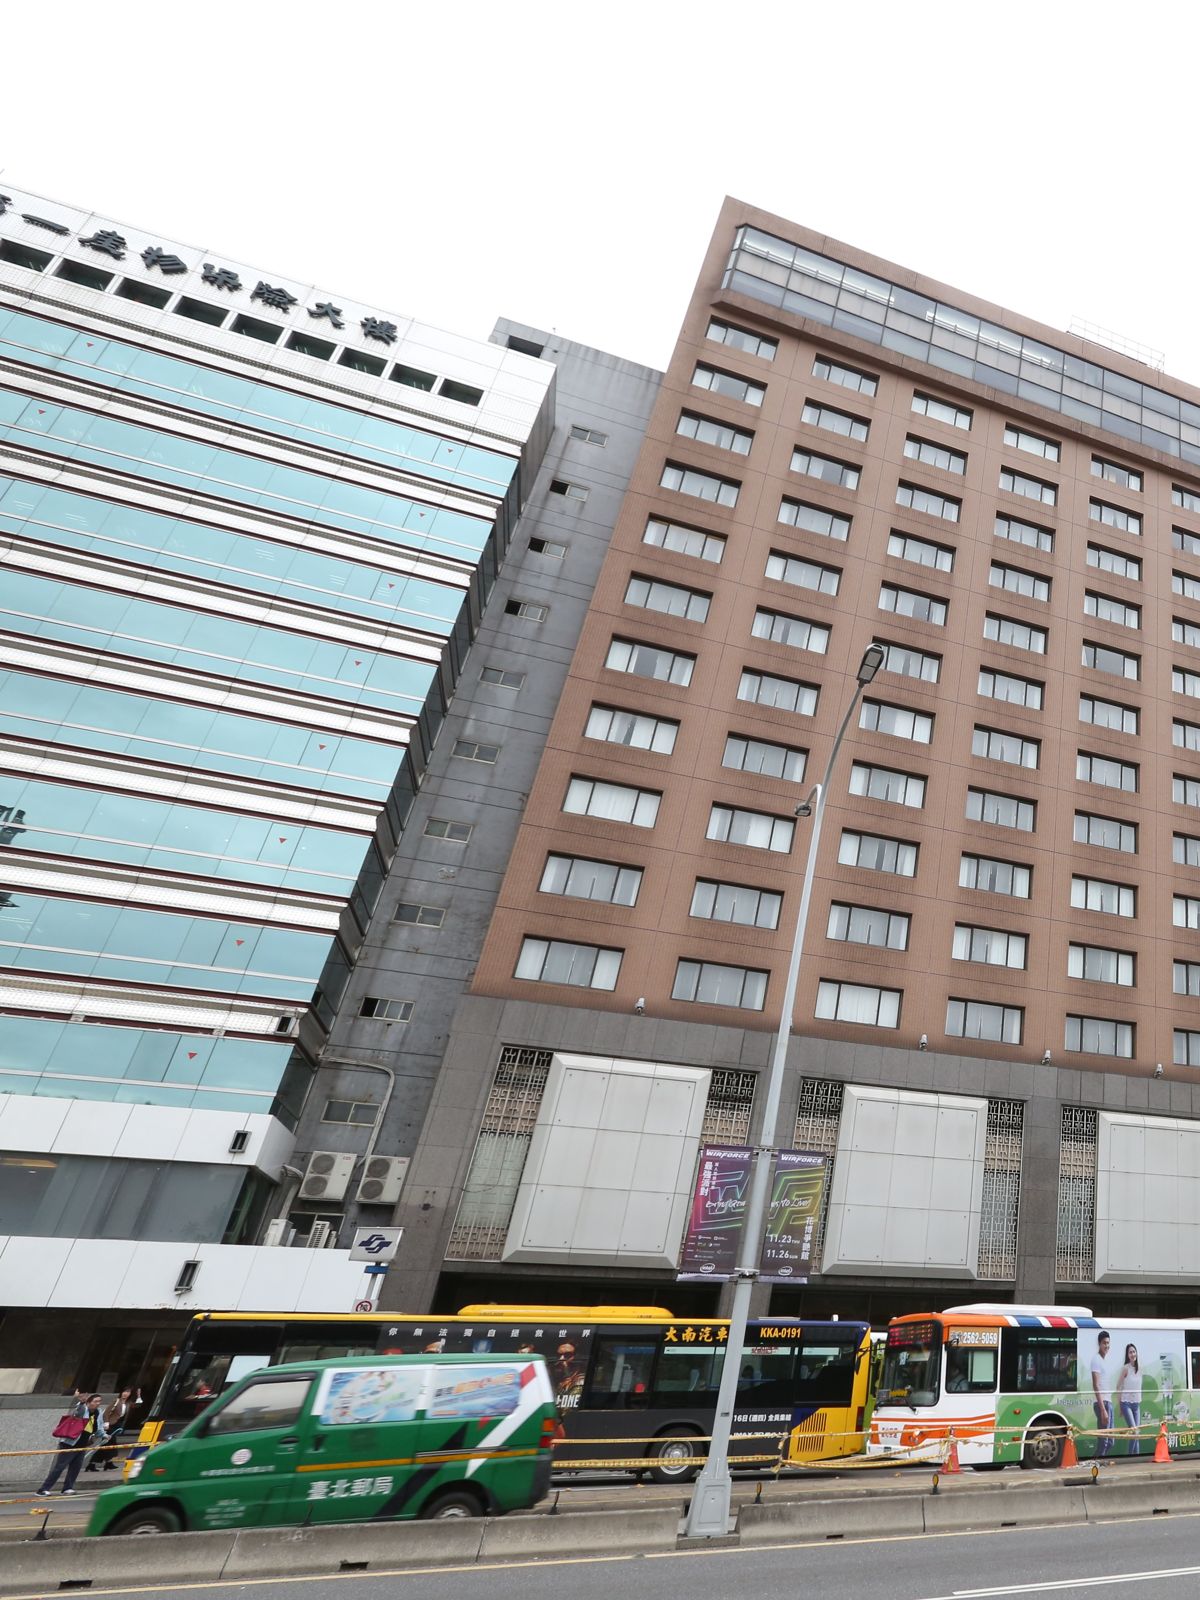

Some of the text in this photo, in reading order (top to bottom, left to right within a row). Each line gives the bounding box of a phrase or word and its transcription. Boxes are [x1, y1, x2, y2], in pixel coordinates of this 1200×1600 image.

[0, 194, 399, 346] 一產物保險大樓
[769, 1234, 792, 1244] 11.23
[767, 1249, 789, 1259] 11.26
[664, 1326, 728, 1342] 大南汽車
[760, 1327, 801, 1338] KKA-0191
[307, 1476, 394, 1500] 臺北郵局
